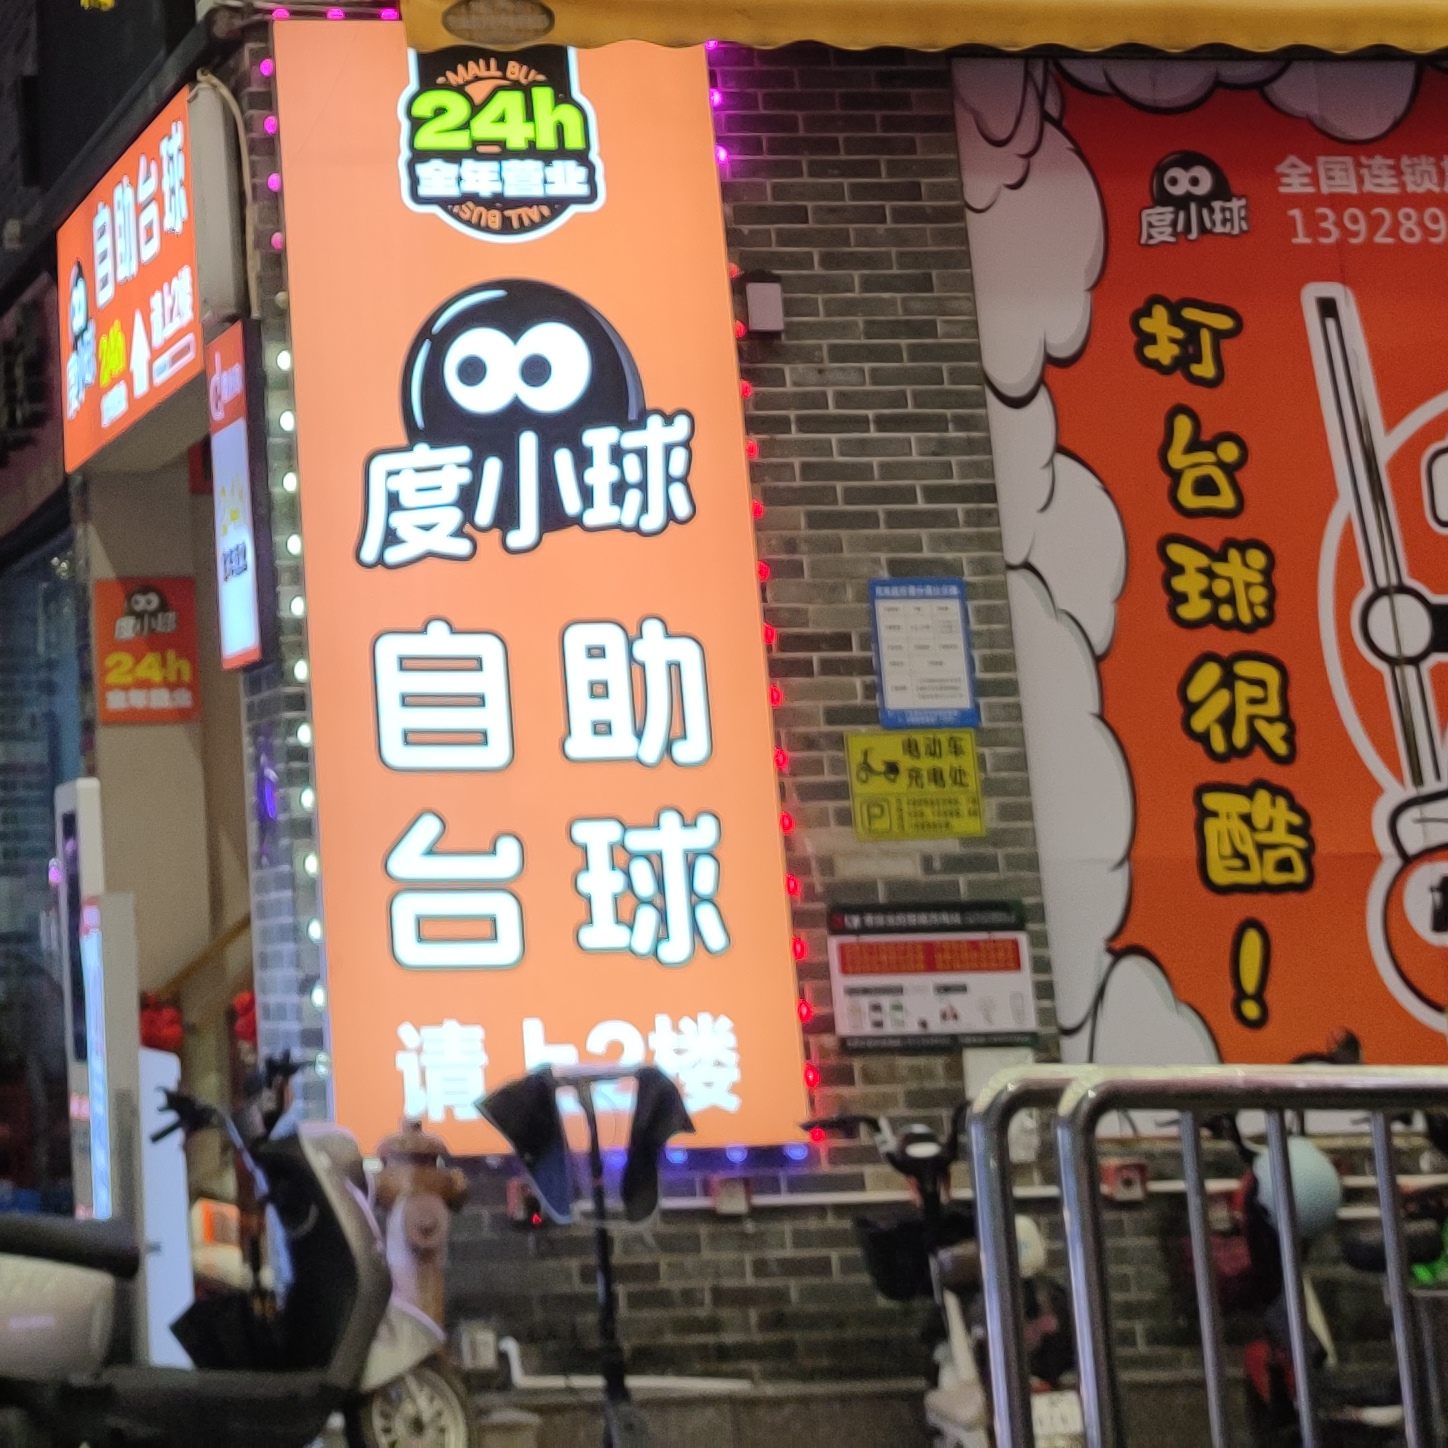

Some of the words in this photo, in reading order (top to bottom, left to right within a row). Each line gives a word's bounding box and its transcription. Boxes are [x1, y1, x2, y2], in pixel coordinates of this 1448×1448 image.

[411, 86, 587, 151] 24h
[436, 57, 504, 87] MALL
[92, 120, 188, 310] 自助台球
[1138, 196, 1249, 246] 度小球
[362, 415, 693, 564] 度小球
[105, 649, 193, 687] 24h
[374, 617, 712, 770] 自助
[386, 808, 730, 968] 台球
[395, 1011, 742, 1124] 请上2楼
